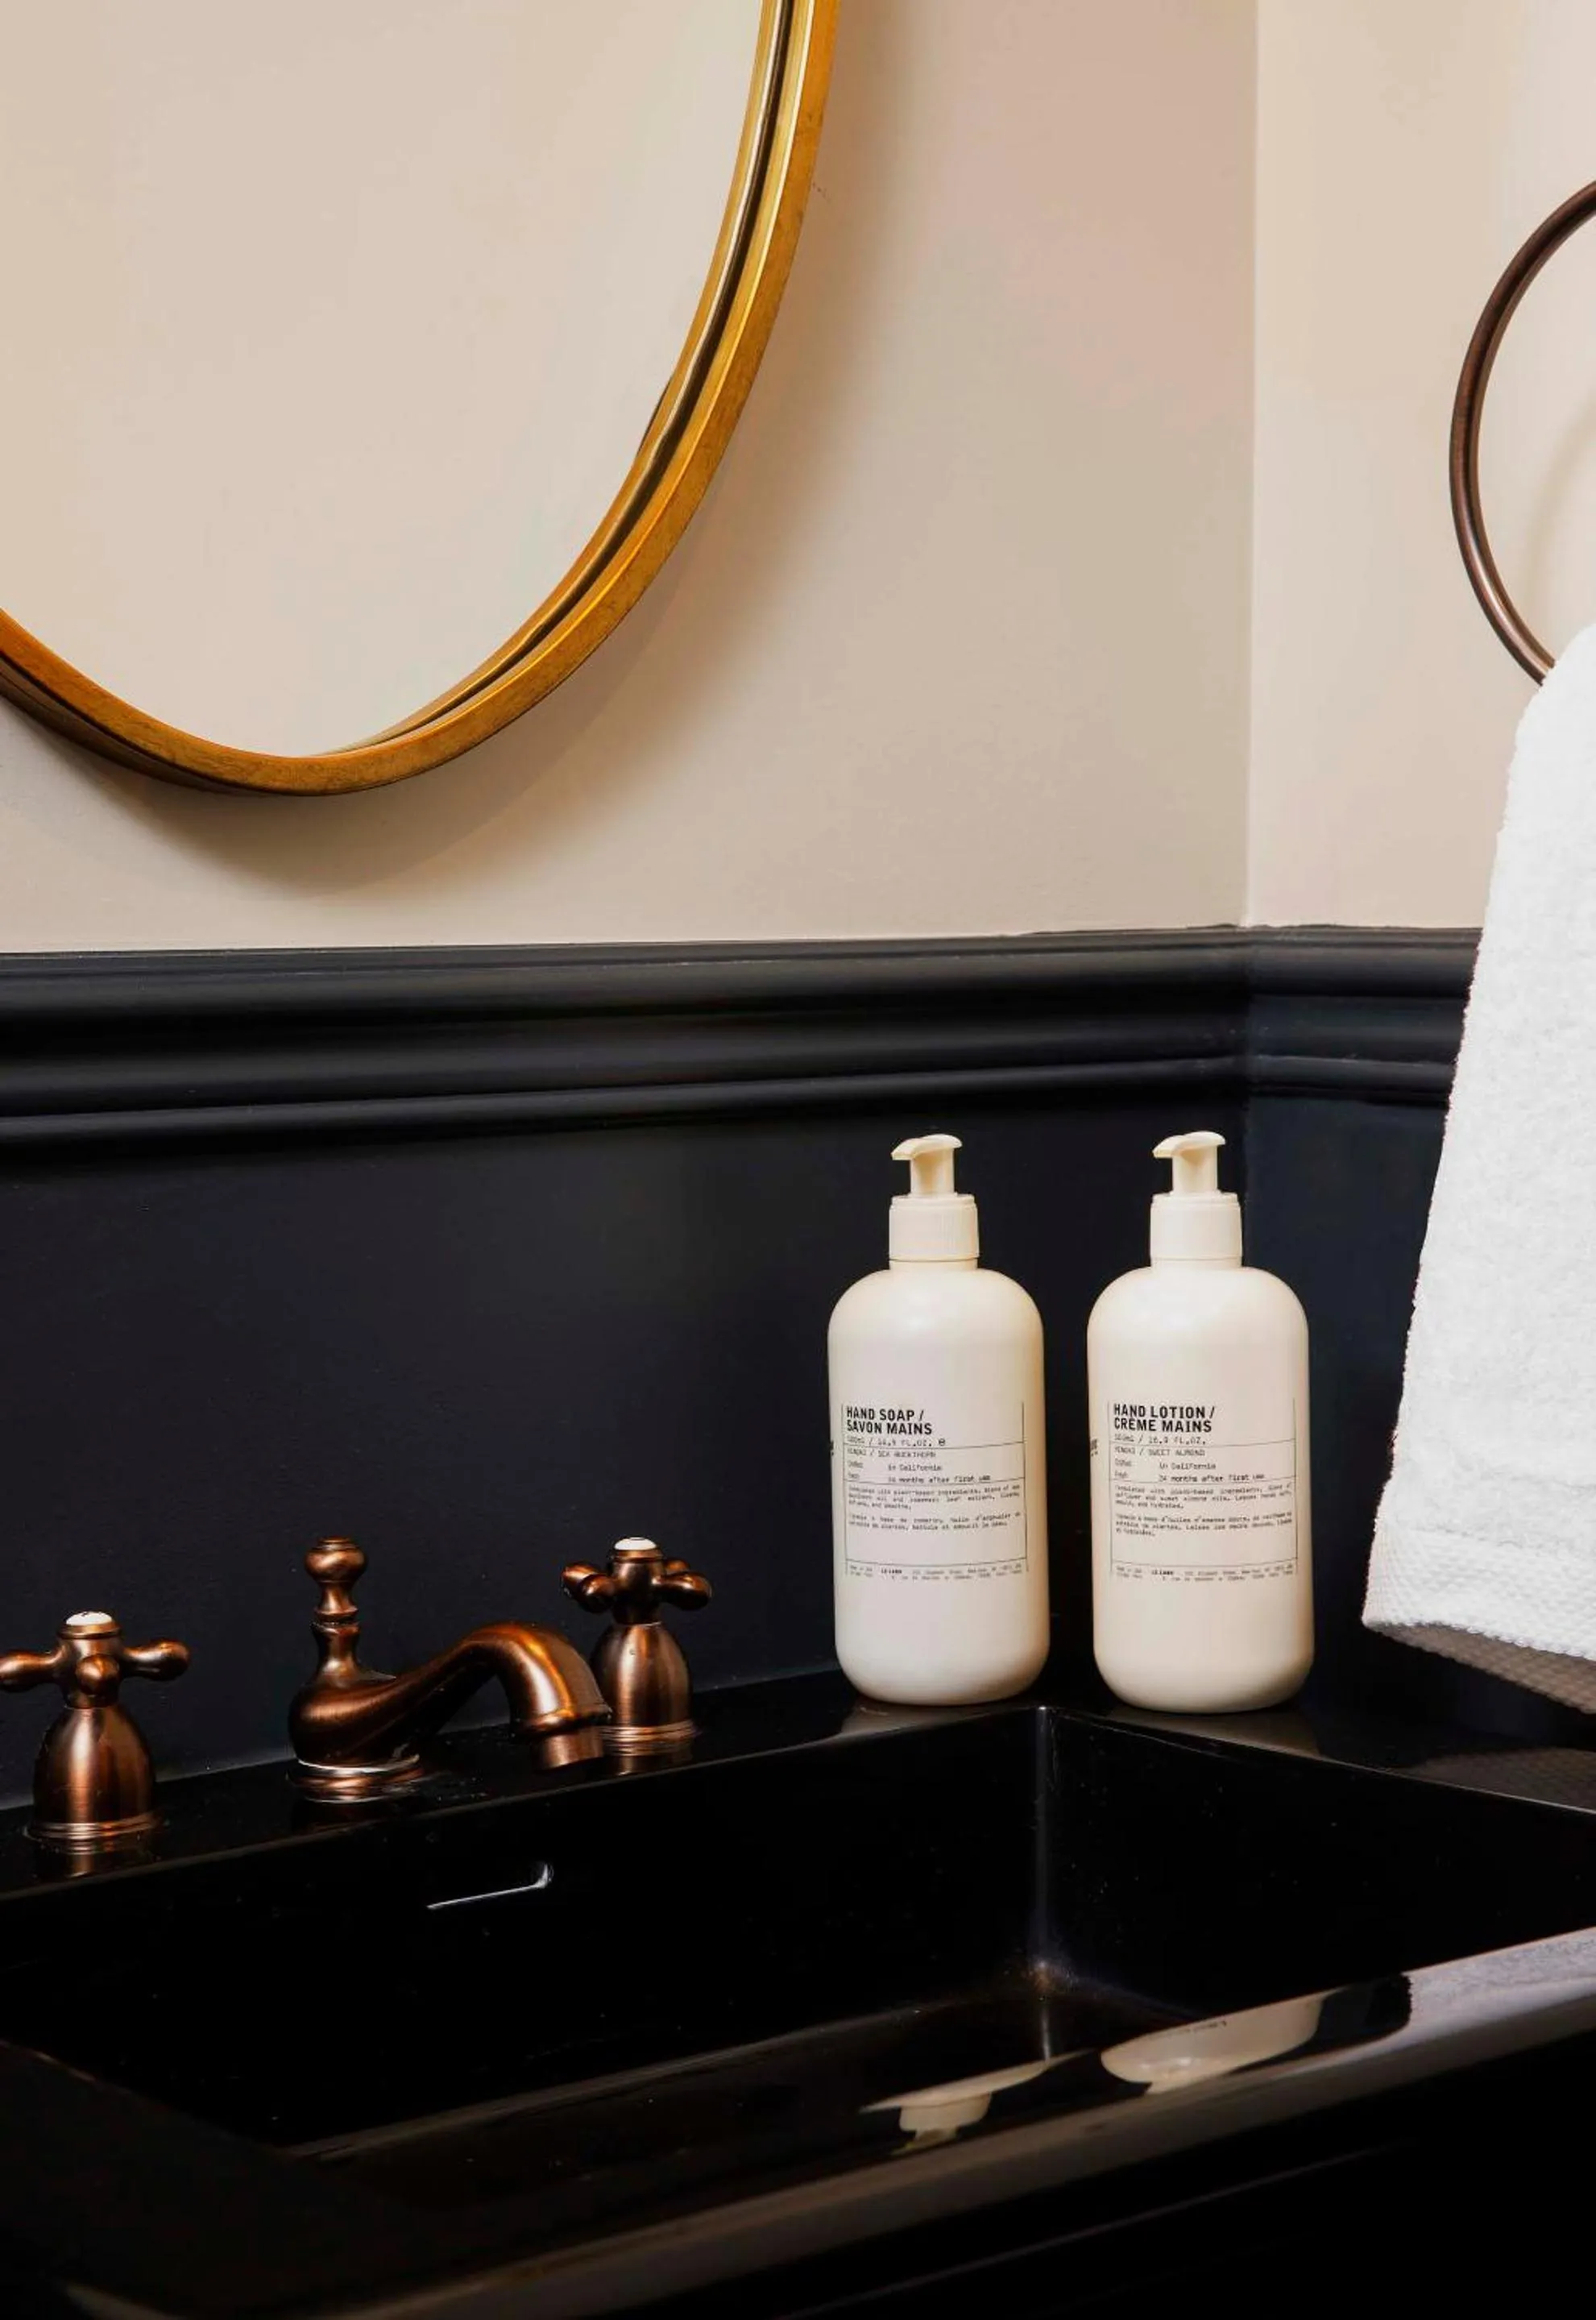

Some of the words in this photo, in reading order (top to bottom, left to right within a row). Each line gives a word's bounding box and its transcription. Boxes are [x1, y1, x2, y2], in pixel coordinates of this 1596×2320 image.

[847, 1406, 875, 1421] HAND
[879, 1409, 914, 1421] SOAP
[1114, 1403, 1146, 1417] HAND
[1150, 1405, 1205, 1419] LOTION
[847, 1419, 882, 1434] SAVON
[887, 1422, 932, 1435] MAINS
[1162, 1419, 1213, 1433] MAINS
